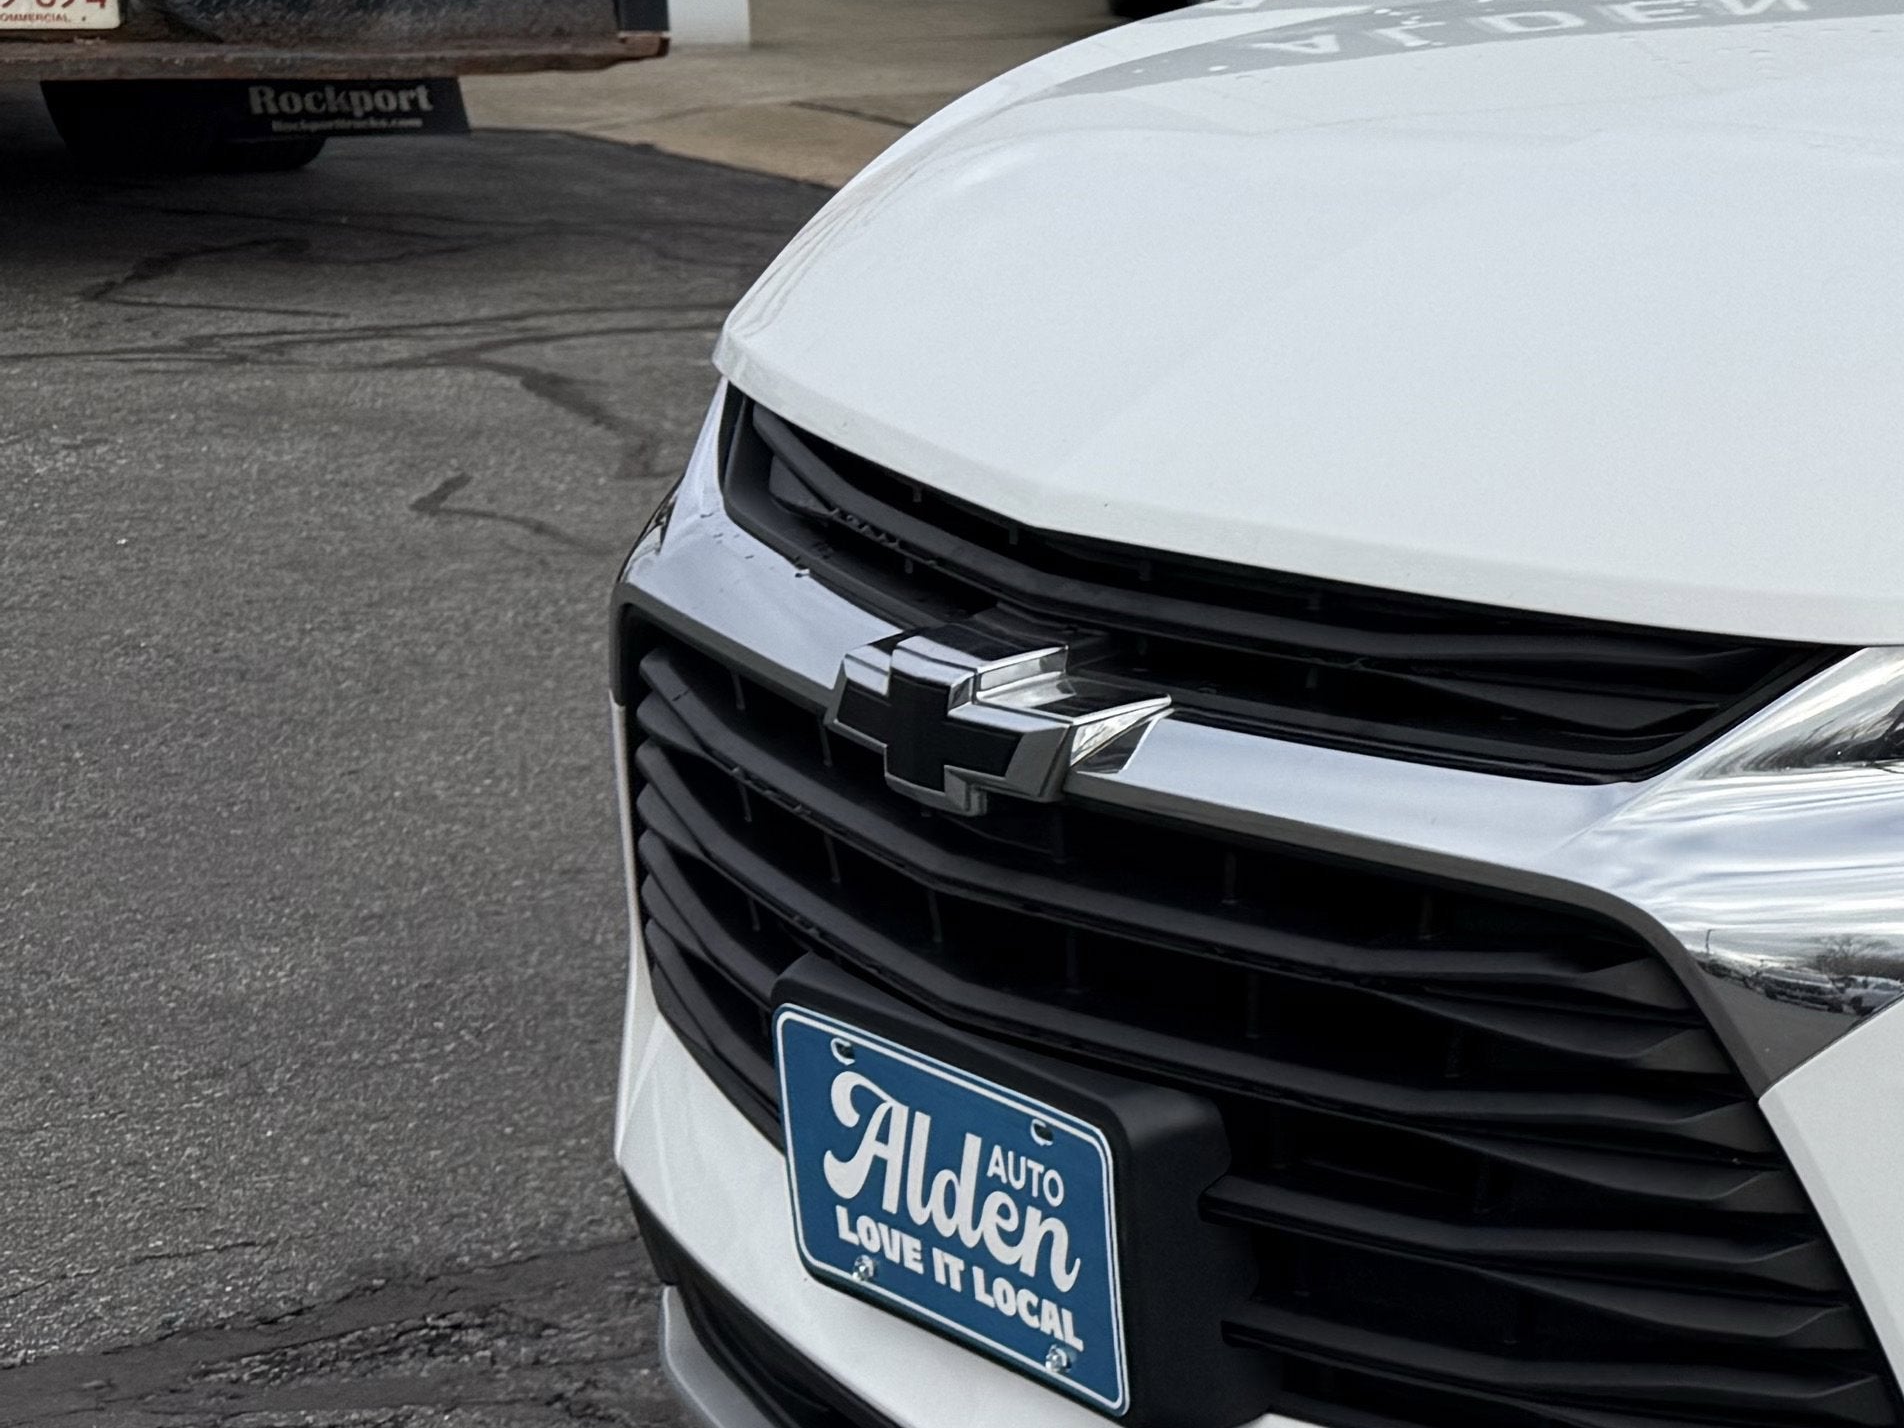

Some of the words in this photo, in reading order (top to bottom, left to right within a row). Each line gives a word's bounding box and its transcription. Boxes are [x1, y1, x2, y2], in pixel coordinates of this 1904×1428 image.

[249, 85, 434, 117] Rockport
[823, 1071, 1081, 1292] Alden
[986, 1144, 1065, 1207] AUTO
[834, 1205, 924, 1274] LOVE
[932, 1246, 966, 1293] IT
[972, 1265, 1084, 1352] LOCAL
